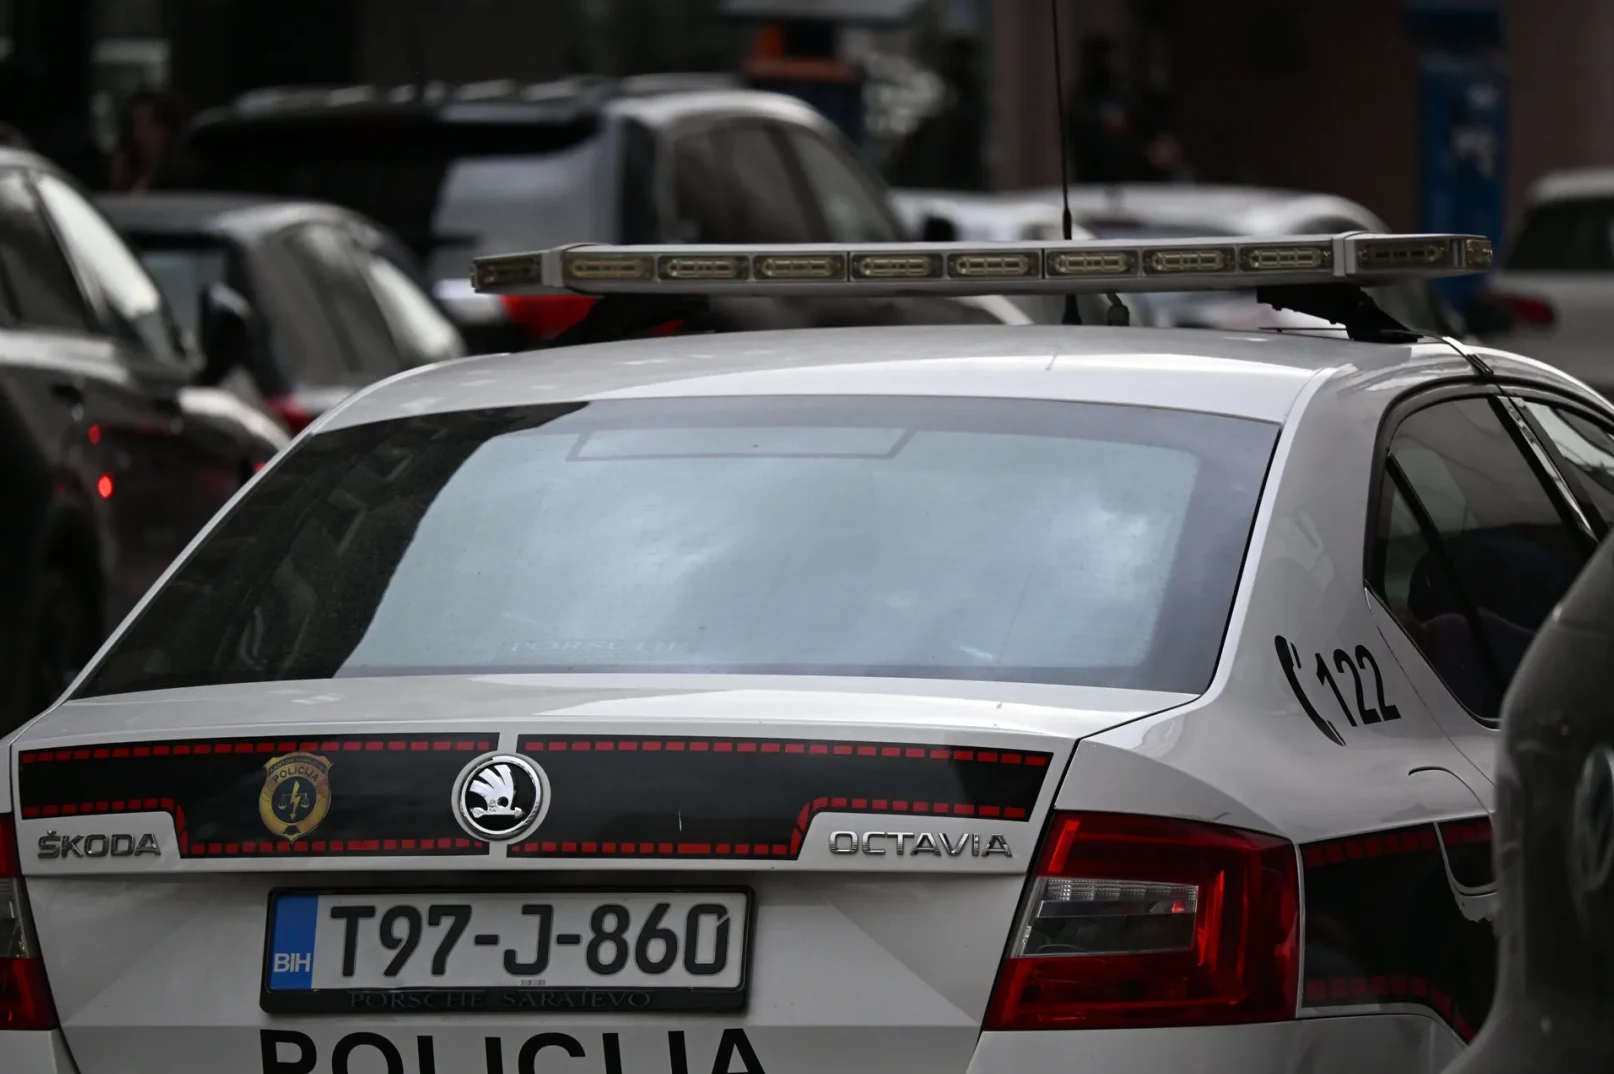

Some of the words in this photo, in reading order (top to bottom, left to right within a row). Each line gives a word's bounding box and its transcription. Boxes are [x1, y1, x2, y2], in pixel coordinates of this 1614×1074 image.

[1314, 644, 1402, 727] 122
[272, 766, 319, 783] POLICIJA
[37, 829, 162, 859] ŠKODA
[828, 830, 1014, 857] OCTAVIA
[330, 902, 730, 977] T97-J-860
[272, 952, 312, 973] BIH
[350, 991, 486, 1009] PORSCHE
[502, 990, 652, 1009] SARAJEVO
